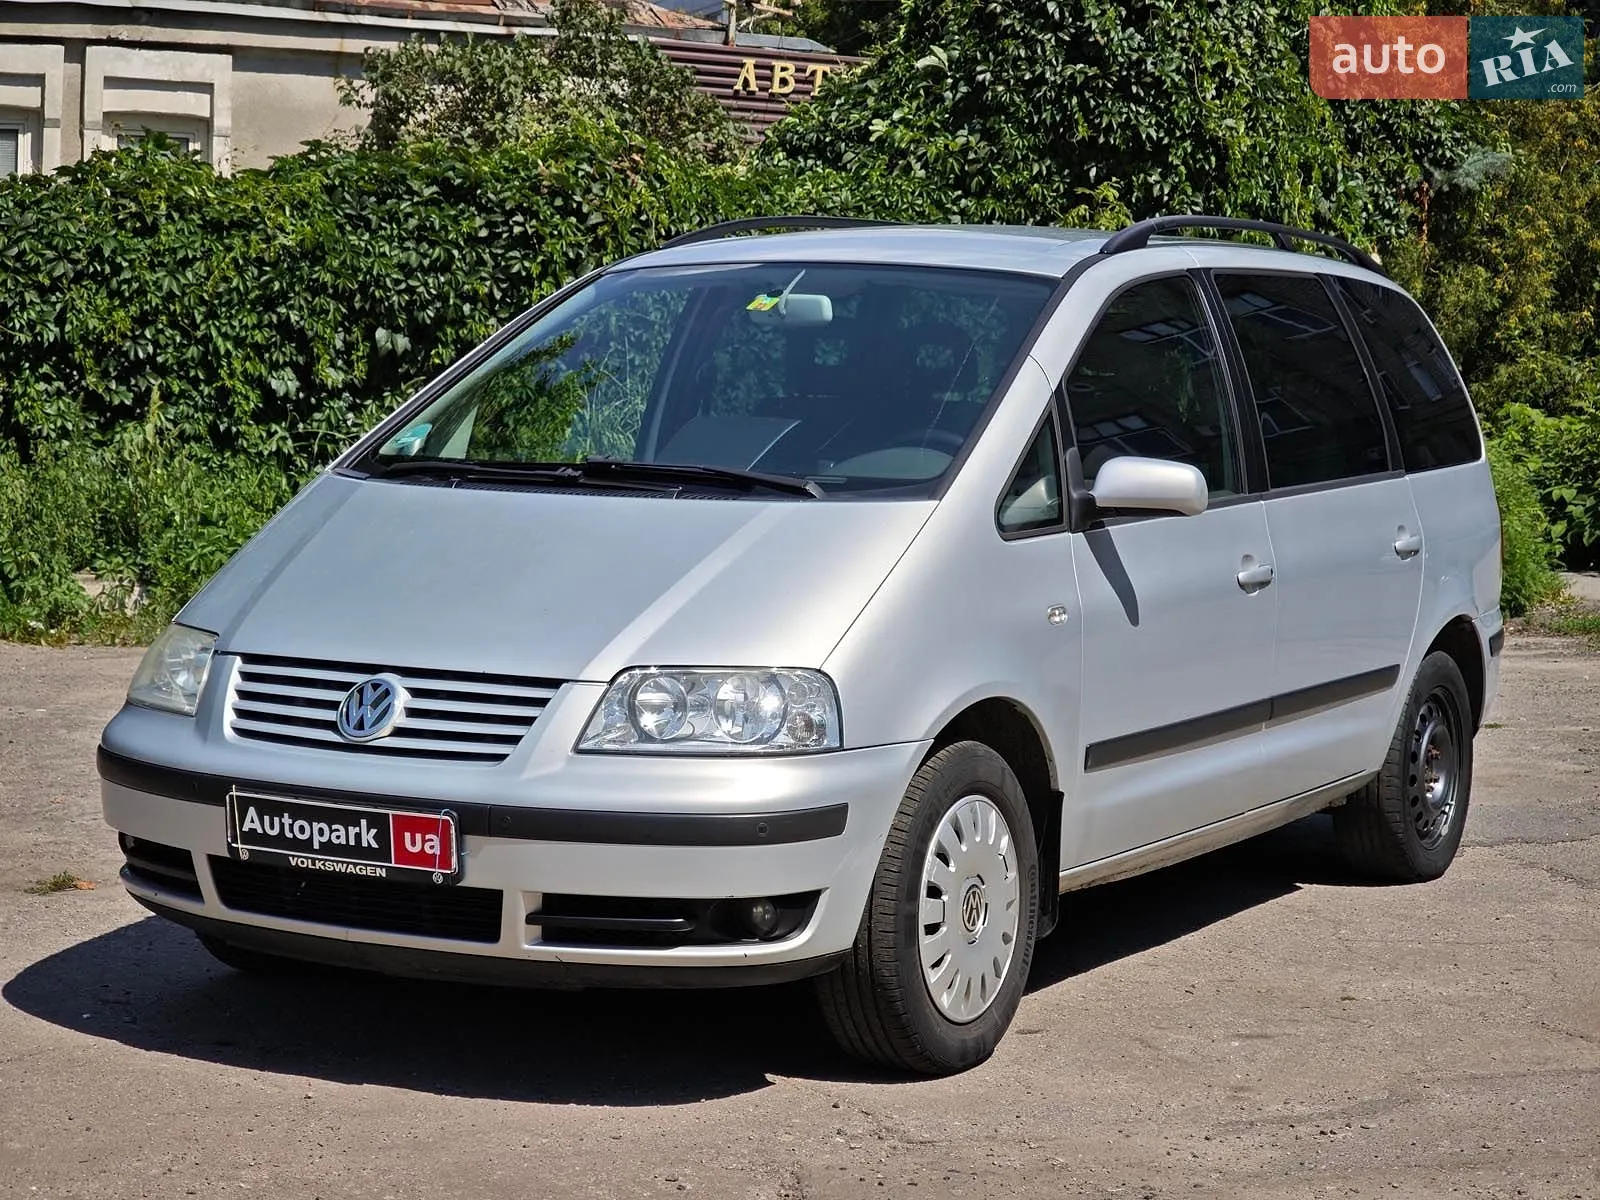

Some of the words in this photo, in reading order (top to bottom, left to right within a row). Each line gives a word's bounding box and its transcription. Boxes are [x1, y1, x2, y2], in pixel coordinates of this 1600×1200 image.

[242, 806, 380, 850] Autopark
[404, 831, 440, 855] ua
[288, 856, 387, 878] VOLKSWAGEN
